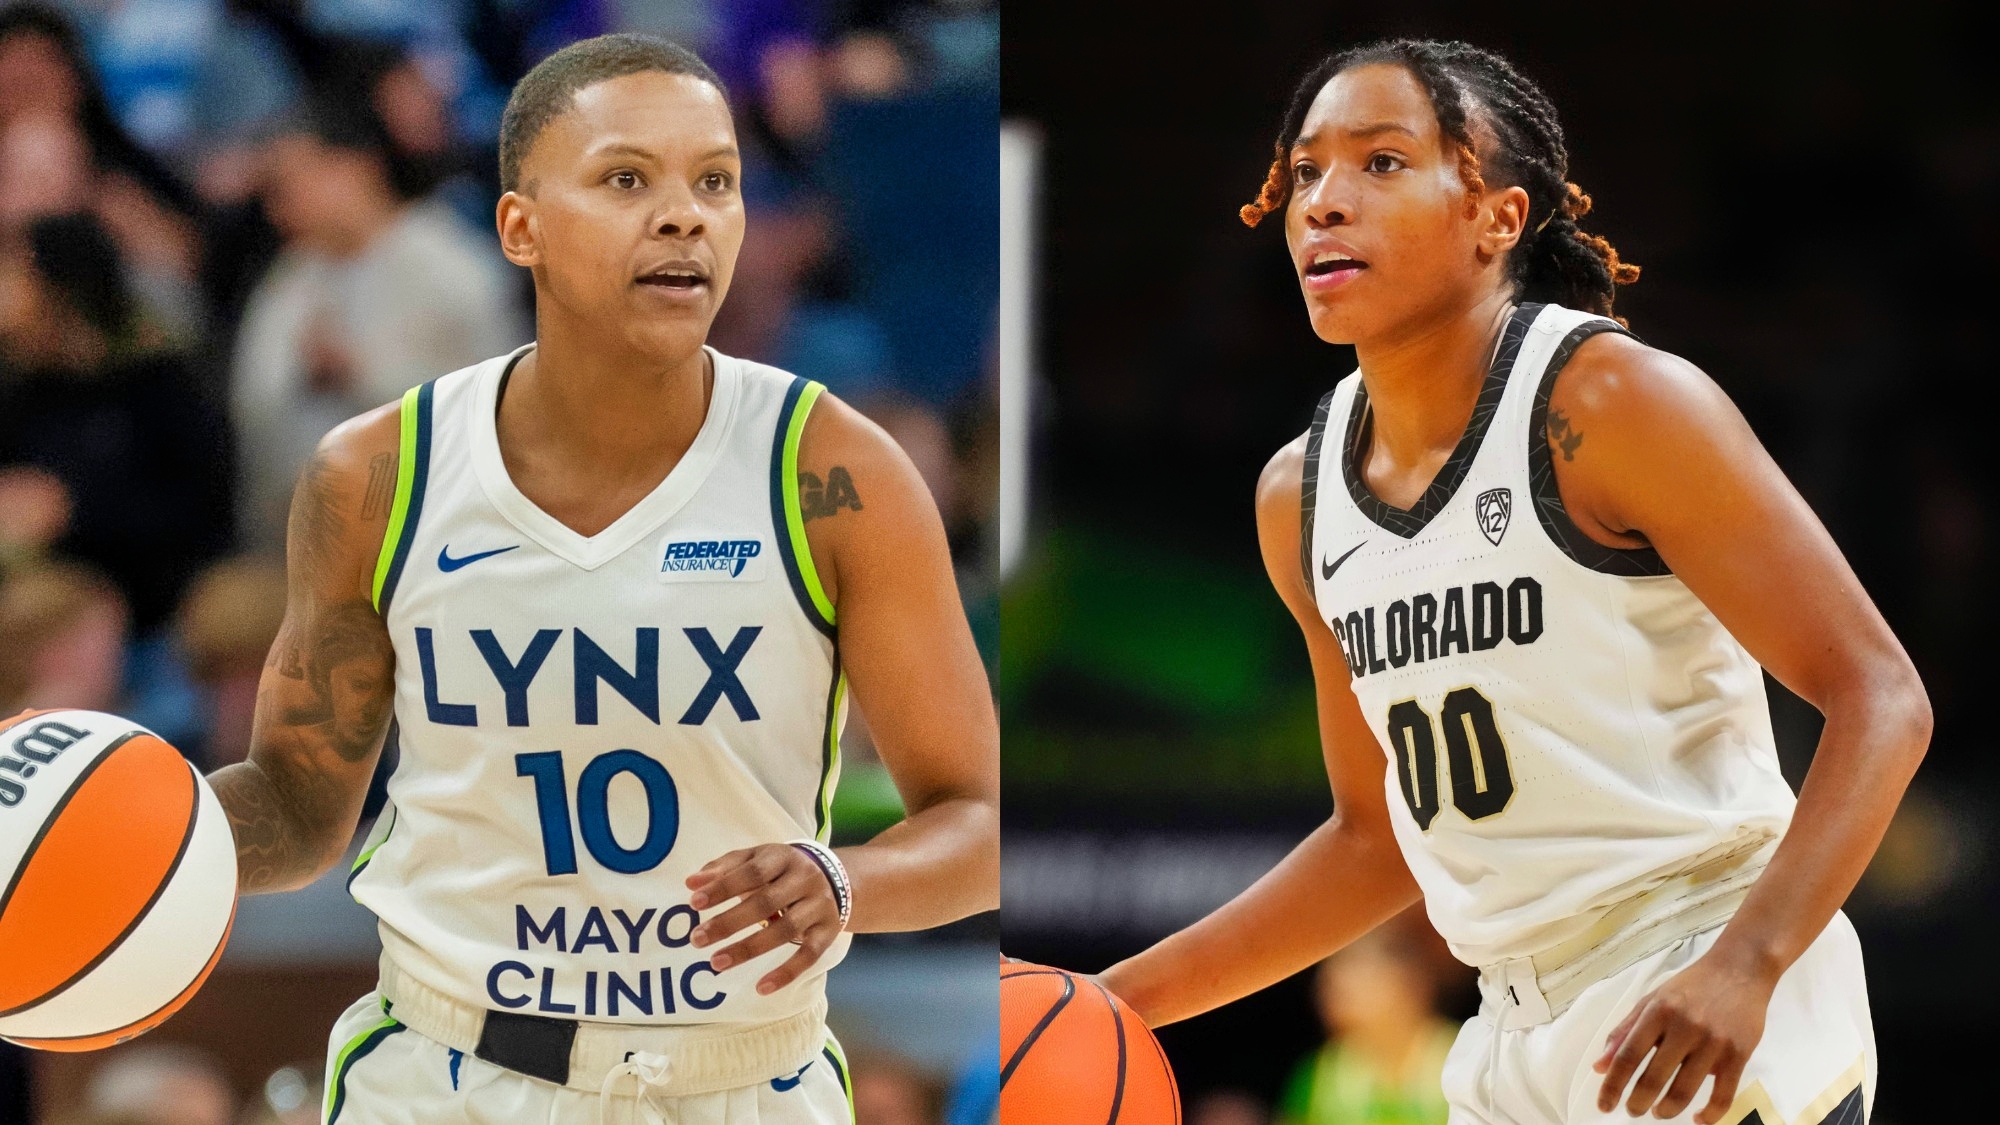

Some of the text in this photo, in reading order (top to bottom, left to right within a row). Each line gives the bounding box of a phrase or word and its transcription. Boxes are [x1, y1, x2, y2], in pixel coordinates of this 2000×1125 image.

[1479, 491, 1508, 524] PAC
[1486, 512, 1502, 533] 12
[661, 559, 729, 572] INSURANCE
[664, 540, 761, 560] FEDERATED
[1331, 576, 1544, 680] COLORADO
[414, 626, 764, 727] LYNX
[1387, 684, 1518, 838] 00
[515, 749, 680, 876] 10
[515, 904, 701, 954] MAYO
[486, 960, 727, 1016] CLINIC
